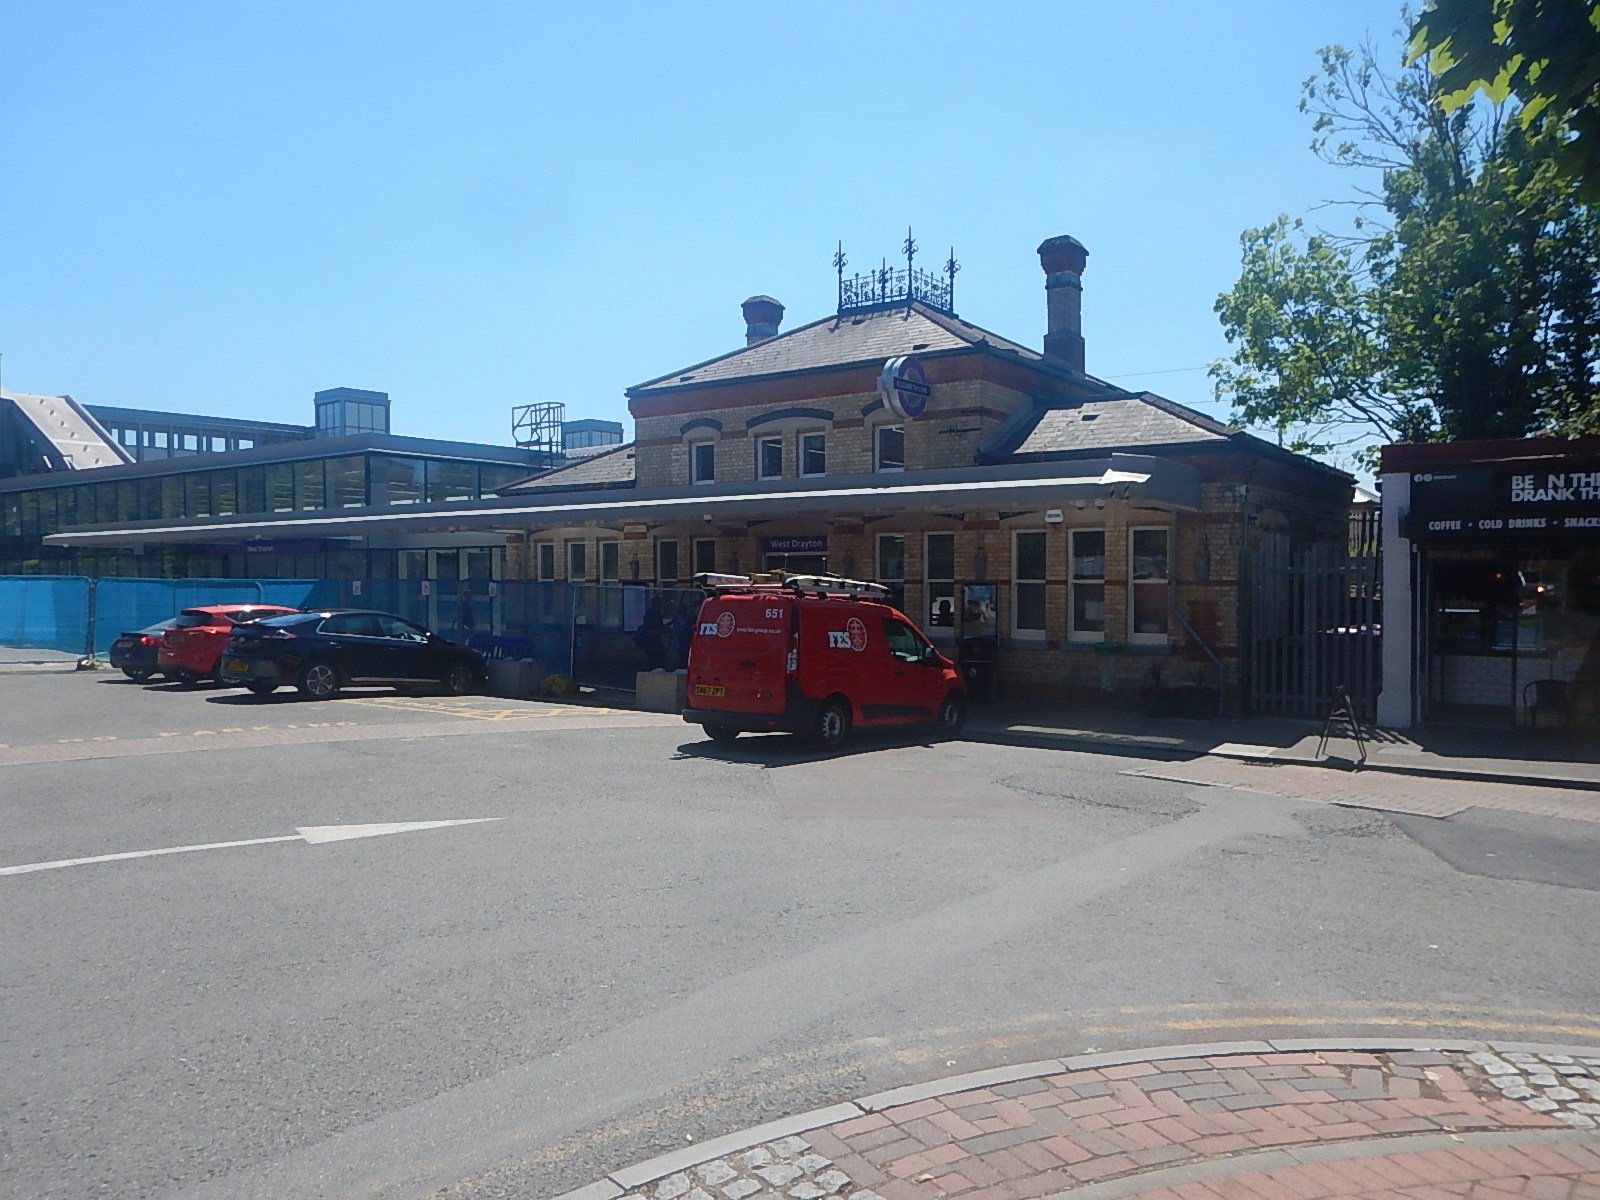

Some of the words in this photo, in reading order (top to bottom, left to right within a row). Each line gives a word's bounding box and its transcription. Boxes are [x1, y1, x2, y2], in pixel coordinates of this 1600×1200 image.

[1511, 487, 1575, 502] DRANK
[1428, 520, 1462, 531] COFFEE
[1478, 519, 1503, 530] COLD
[1508, 517, 1547, 529] DRINKS
[770, 540, 790, 548] West
[791, 539, 823, 549] Drayton
[765, 608, 784, 619] 651
